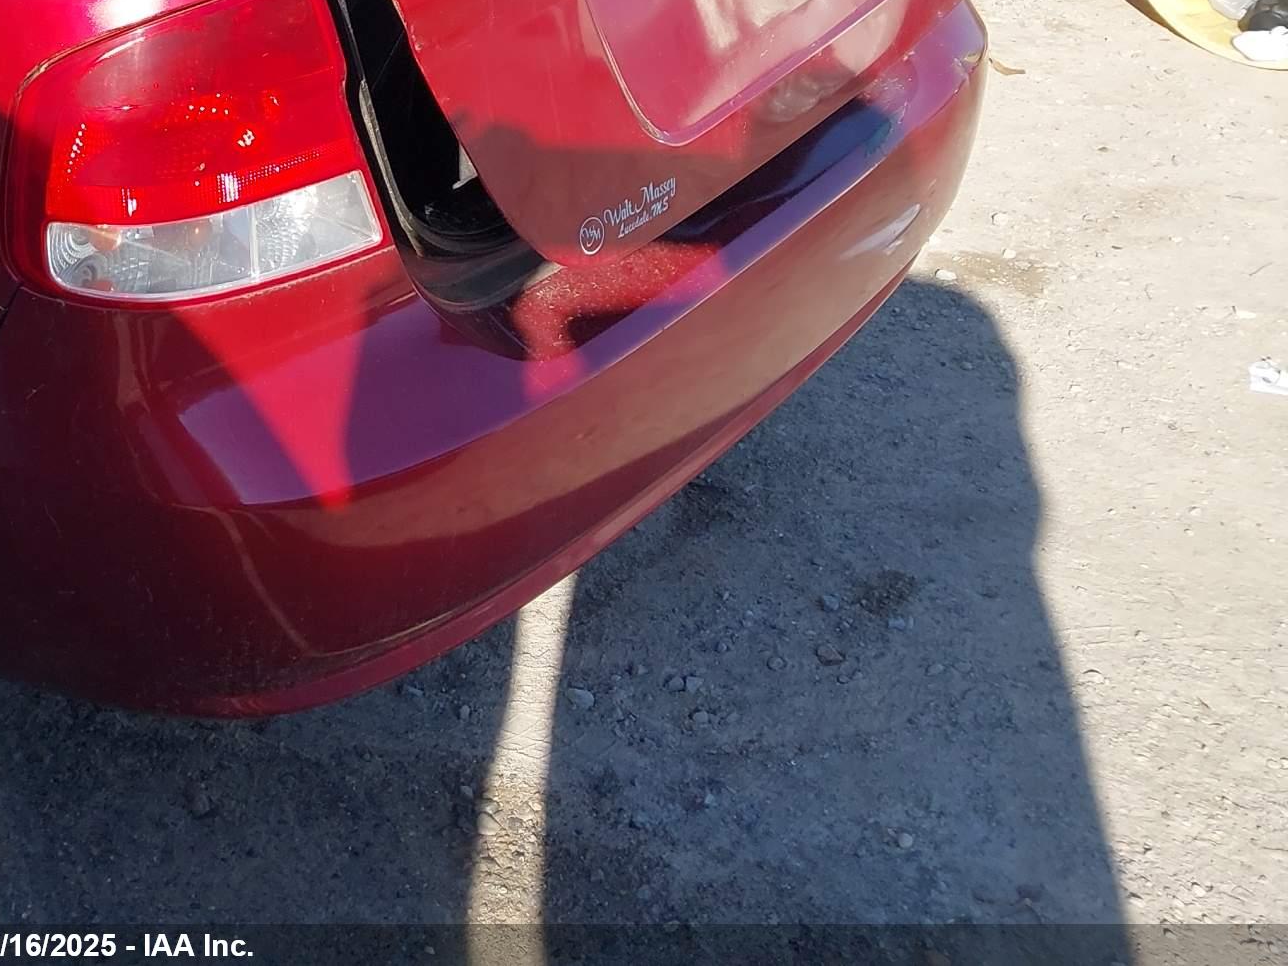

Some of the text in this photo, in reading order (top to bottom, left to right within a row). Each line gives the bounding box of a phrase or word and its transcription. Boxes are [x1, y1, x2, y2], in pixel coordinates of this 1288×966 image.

[604, 177, 676, 227] Walt Massey
[651, 196, 669, 217] MS
